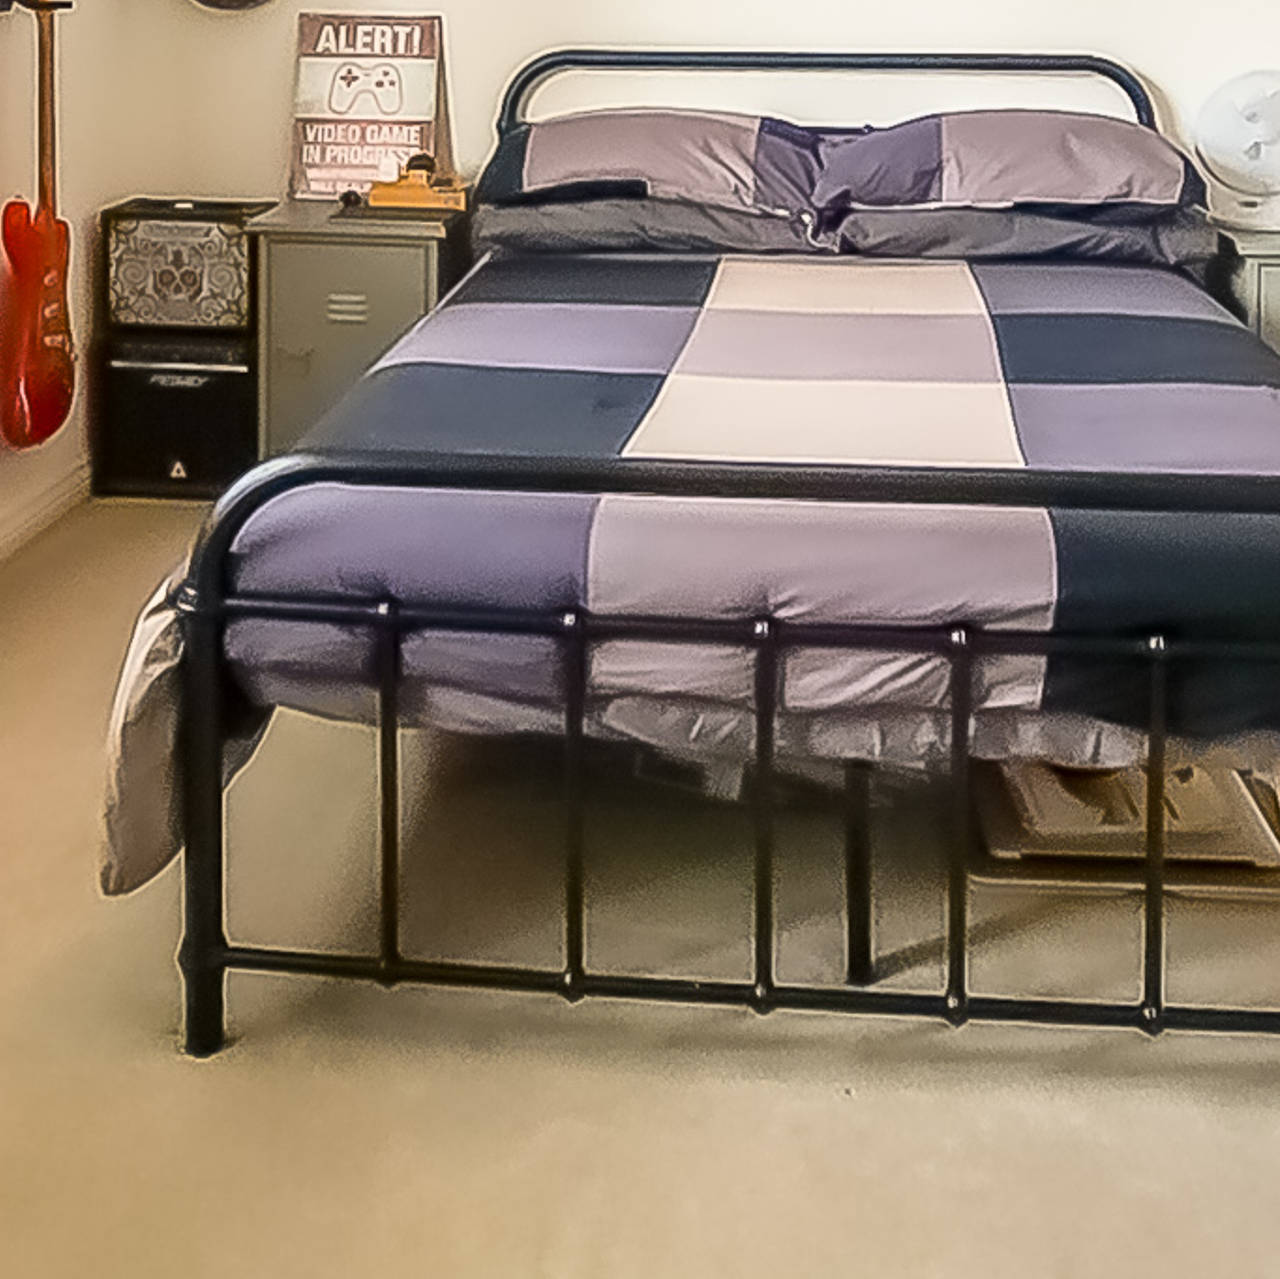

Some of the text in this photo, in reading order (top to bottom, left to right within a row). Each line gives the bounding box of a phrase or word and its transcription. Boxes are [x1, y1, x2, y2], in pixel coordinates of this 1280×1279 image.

[315, 24, 420, 55] ALERT!
[305, 124, 421, 145] VIDEO GAME
[302, 144, 320, 164] IN
